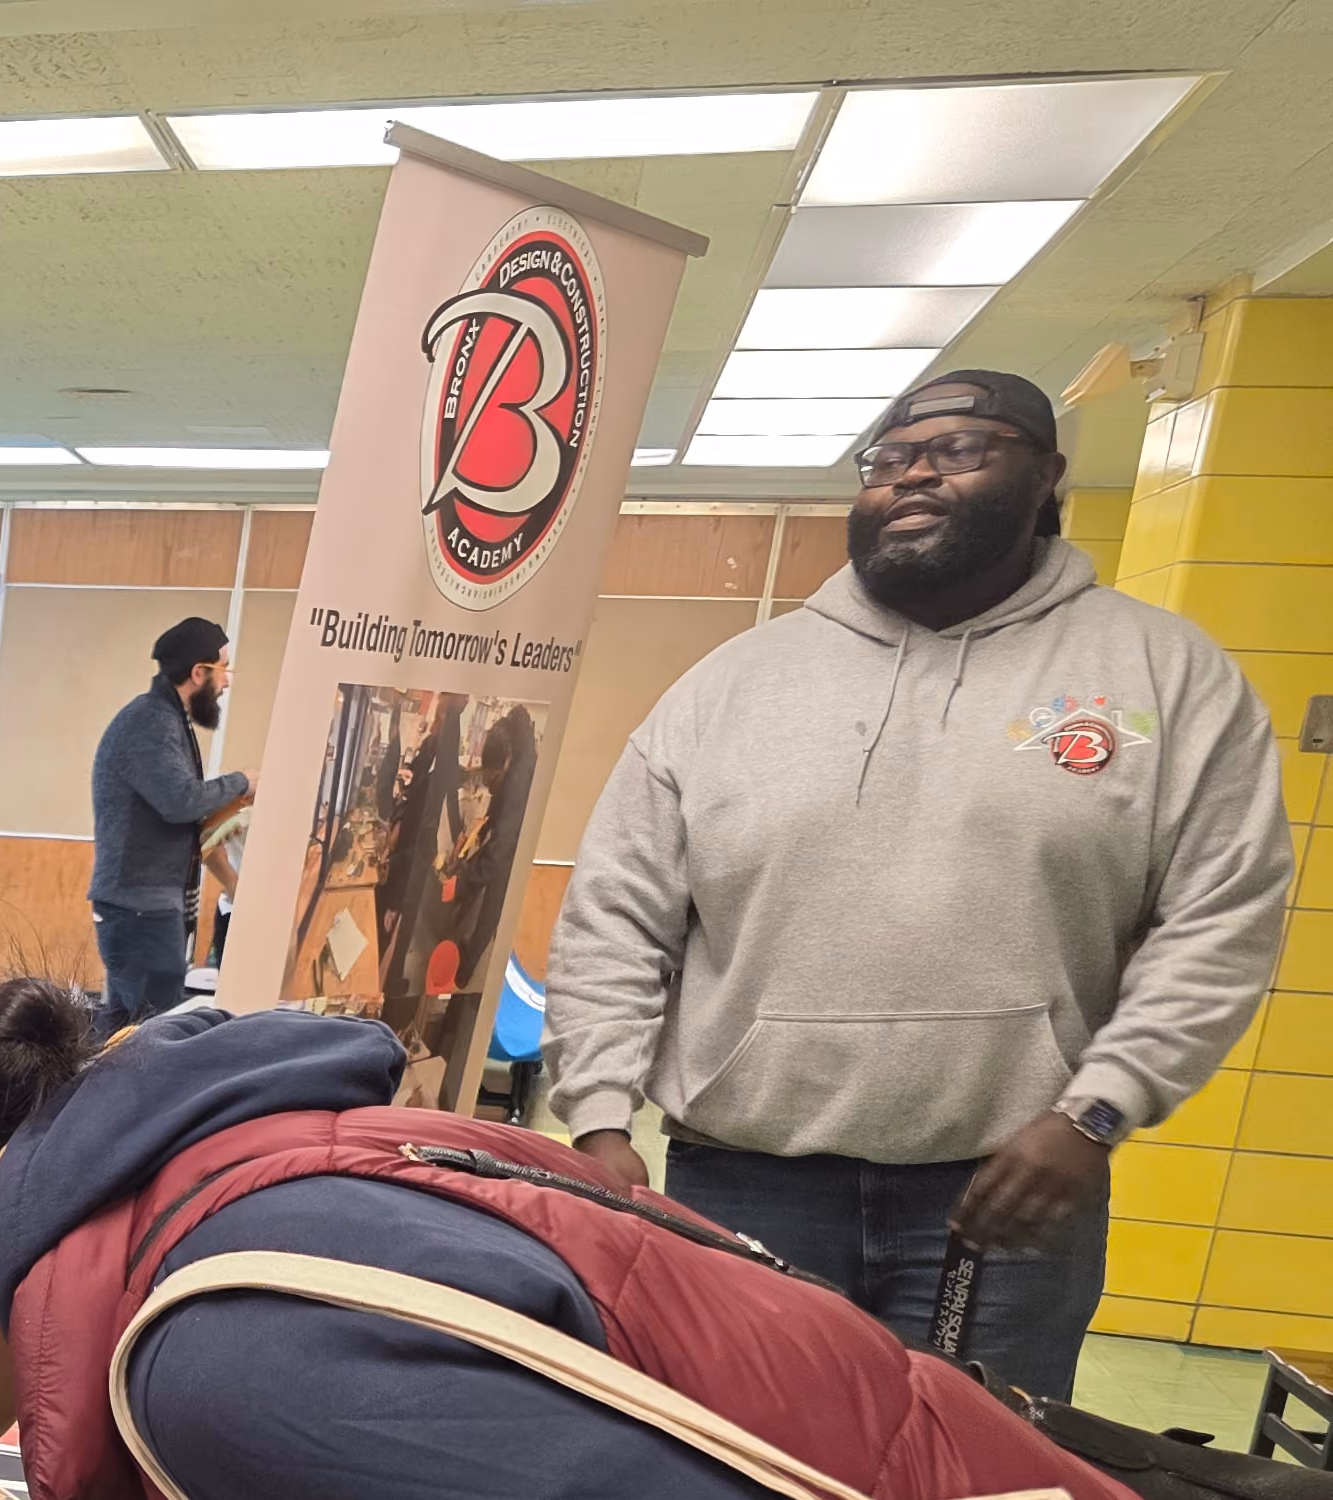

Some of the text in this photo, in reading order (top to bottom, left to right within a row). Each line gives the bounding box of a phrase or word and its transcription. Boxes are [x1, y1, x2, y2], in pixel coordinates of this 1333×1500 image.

[444, 318, 481, 418] BRONX
[499, 250, 591, 447] DESIGN & CONSTRUCTION
[447, 527, 523, 569] ACADEMY
[310, 607, 583, 673] "Building Tomorrow's Leaders"
[942, 1257, 975, 1357] SENPAI SQUA
